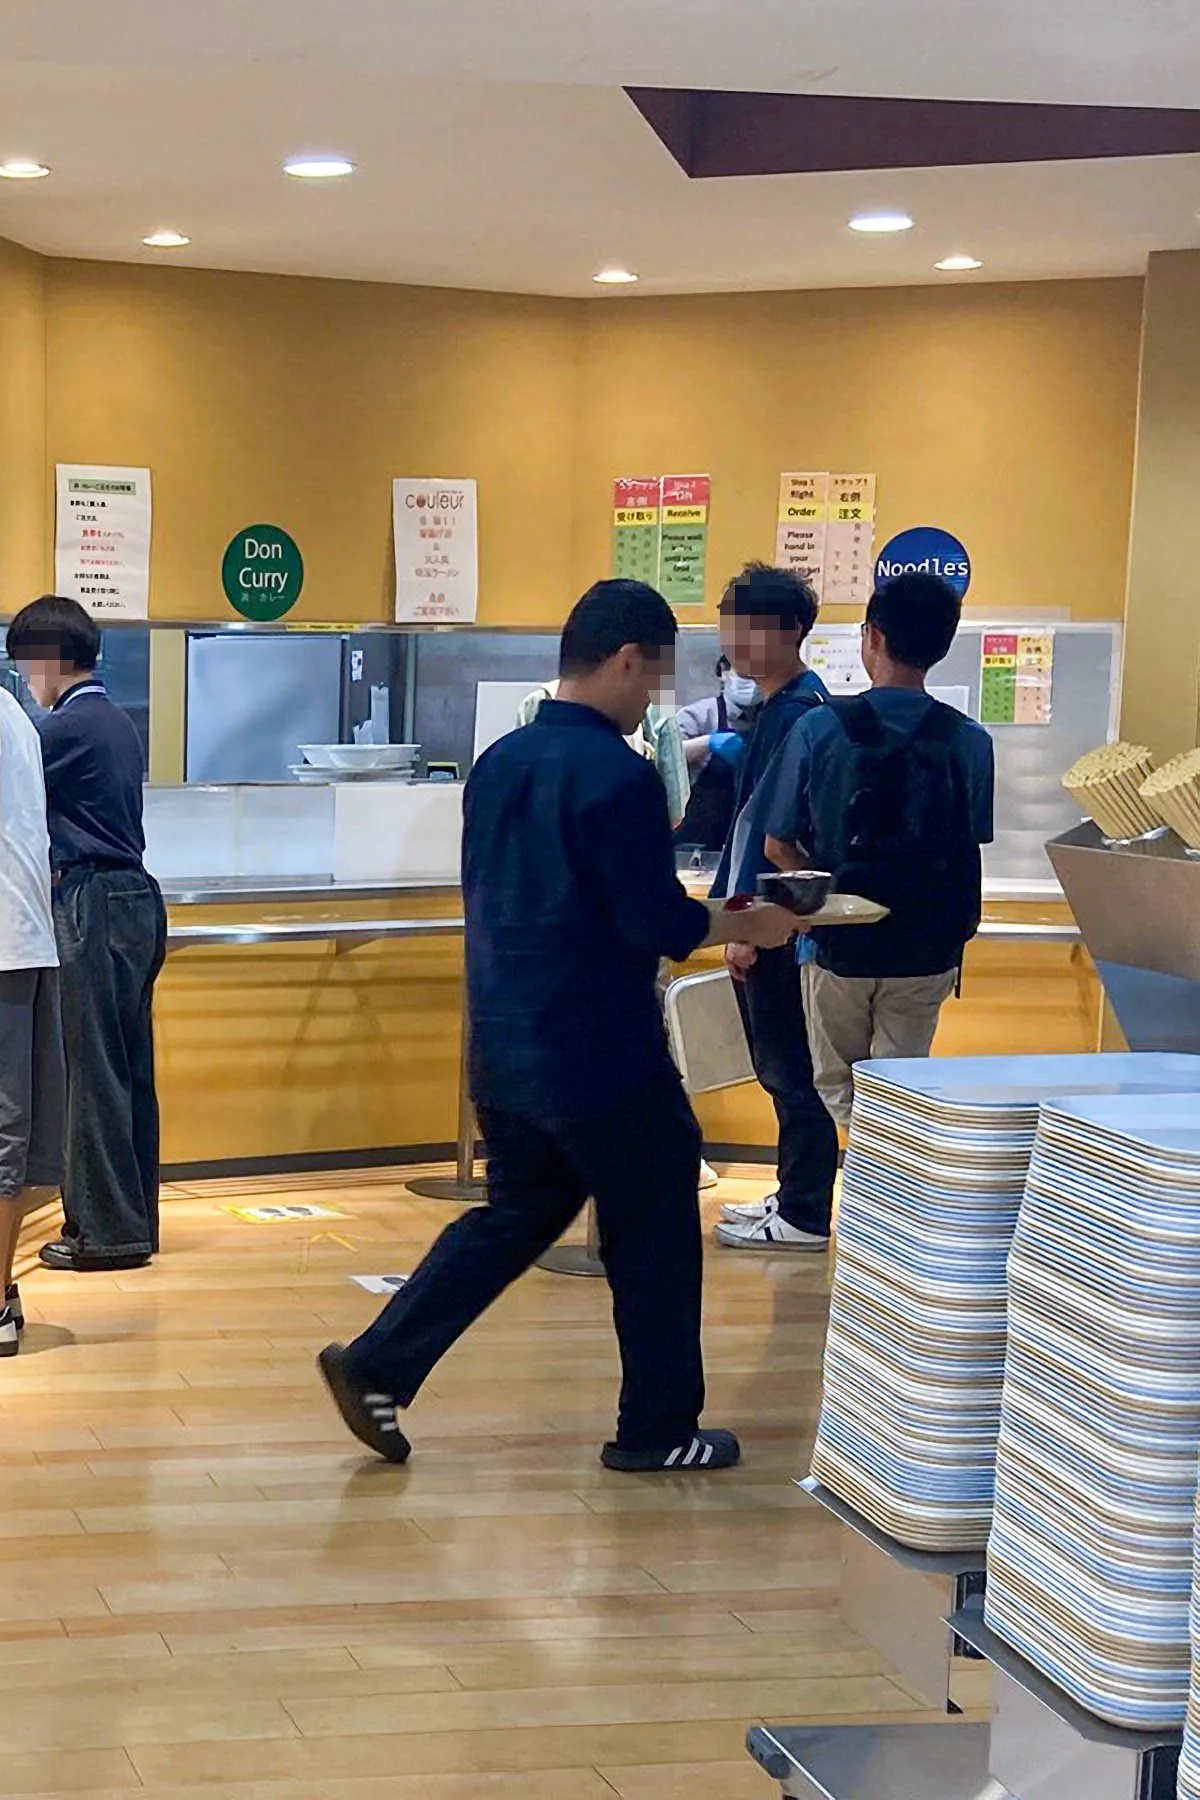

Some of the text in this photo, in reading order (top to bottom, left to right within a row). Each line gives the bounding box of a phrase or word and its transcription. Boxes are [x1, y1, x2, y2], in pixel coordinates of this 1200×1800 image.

[787, 507, 817, 517] Order
[838, 508, 862, 520] 注文
[786, 531, 814, 539] Please
[245, 538, 282, 559] Don
[877, 558, 969, 577] Noodles
[239, 567, 289, 594] Curry
